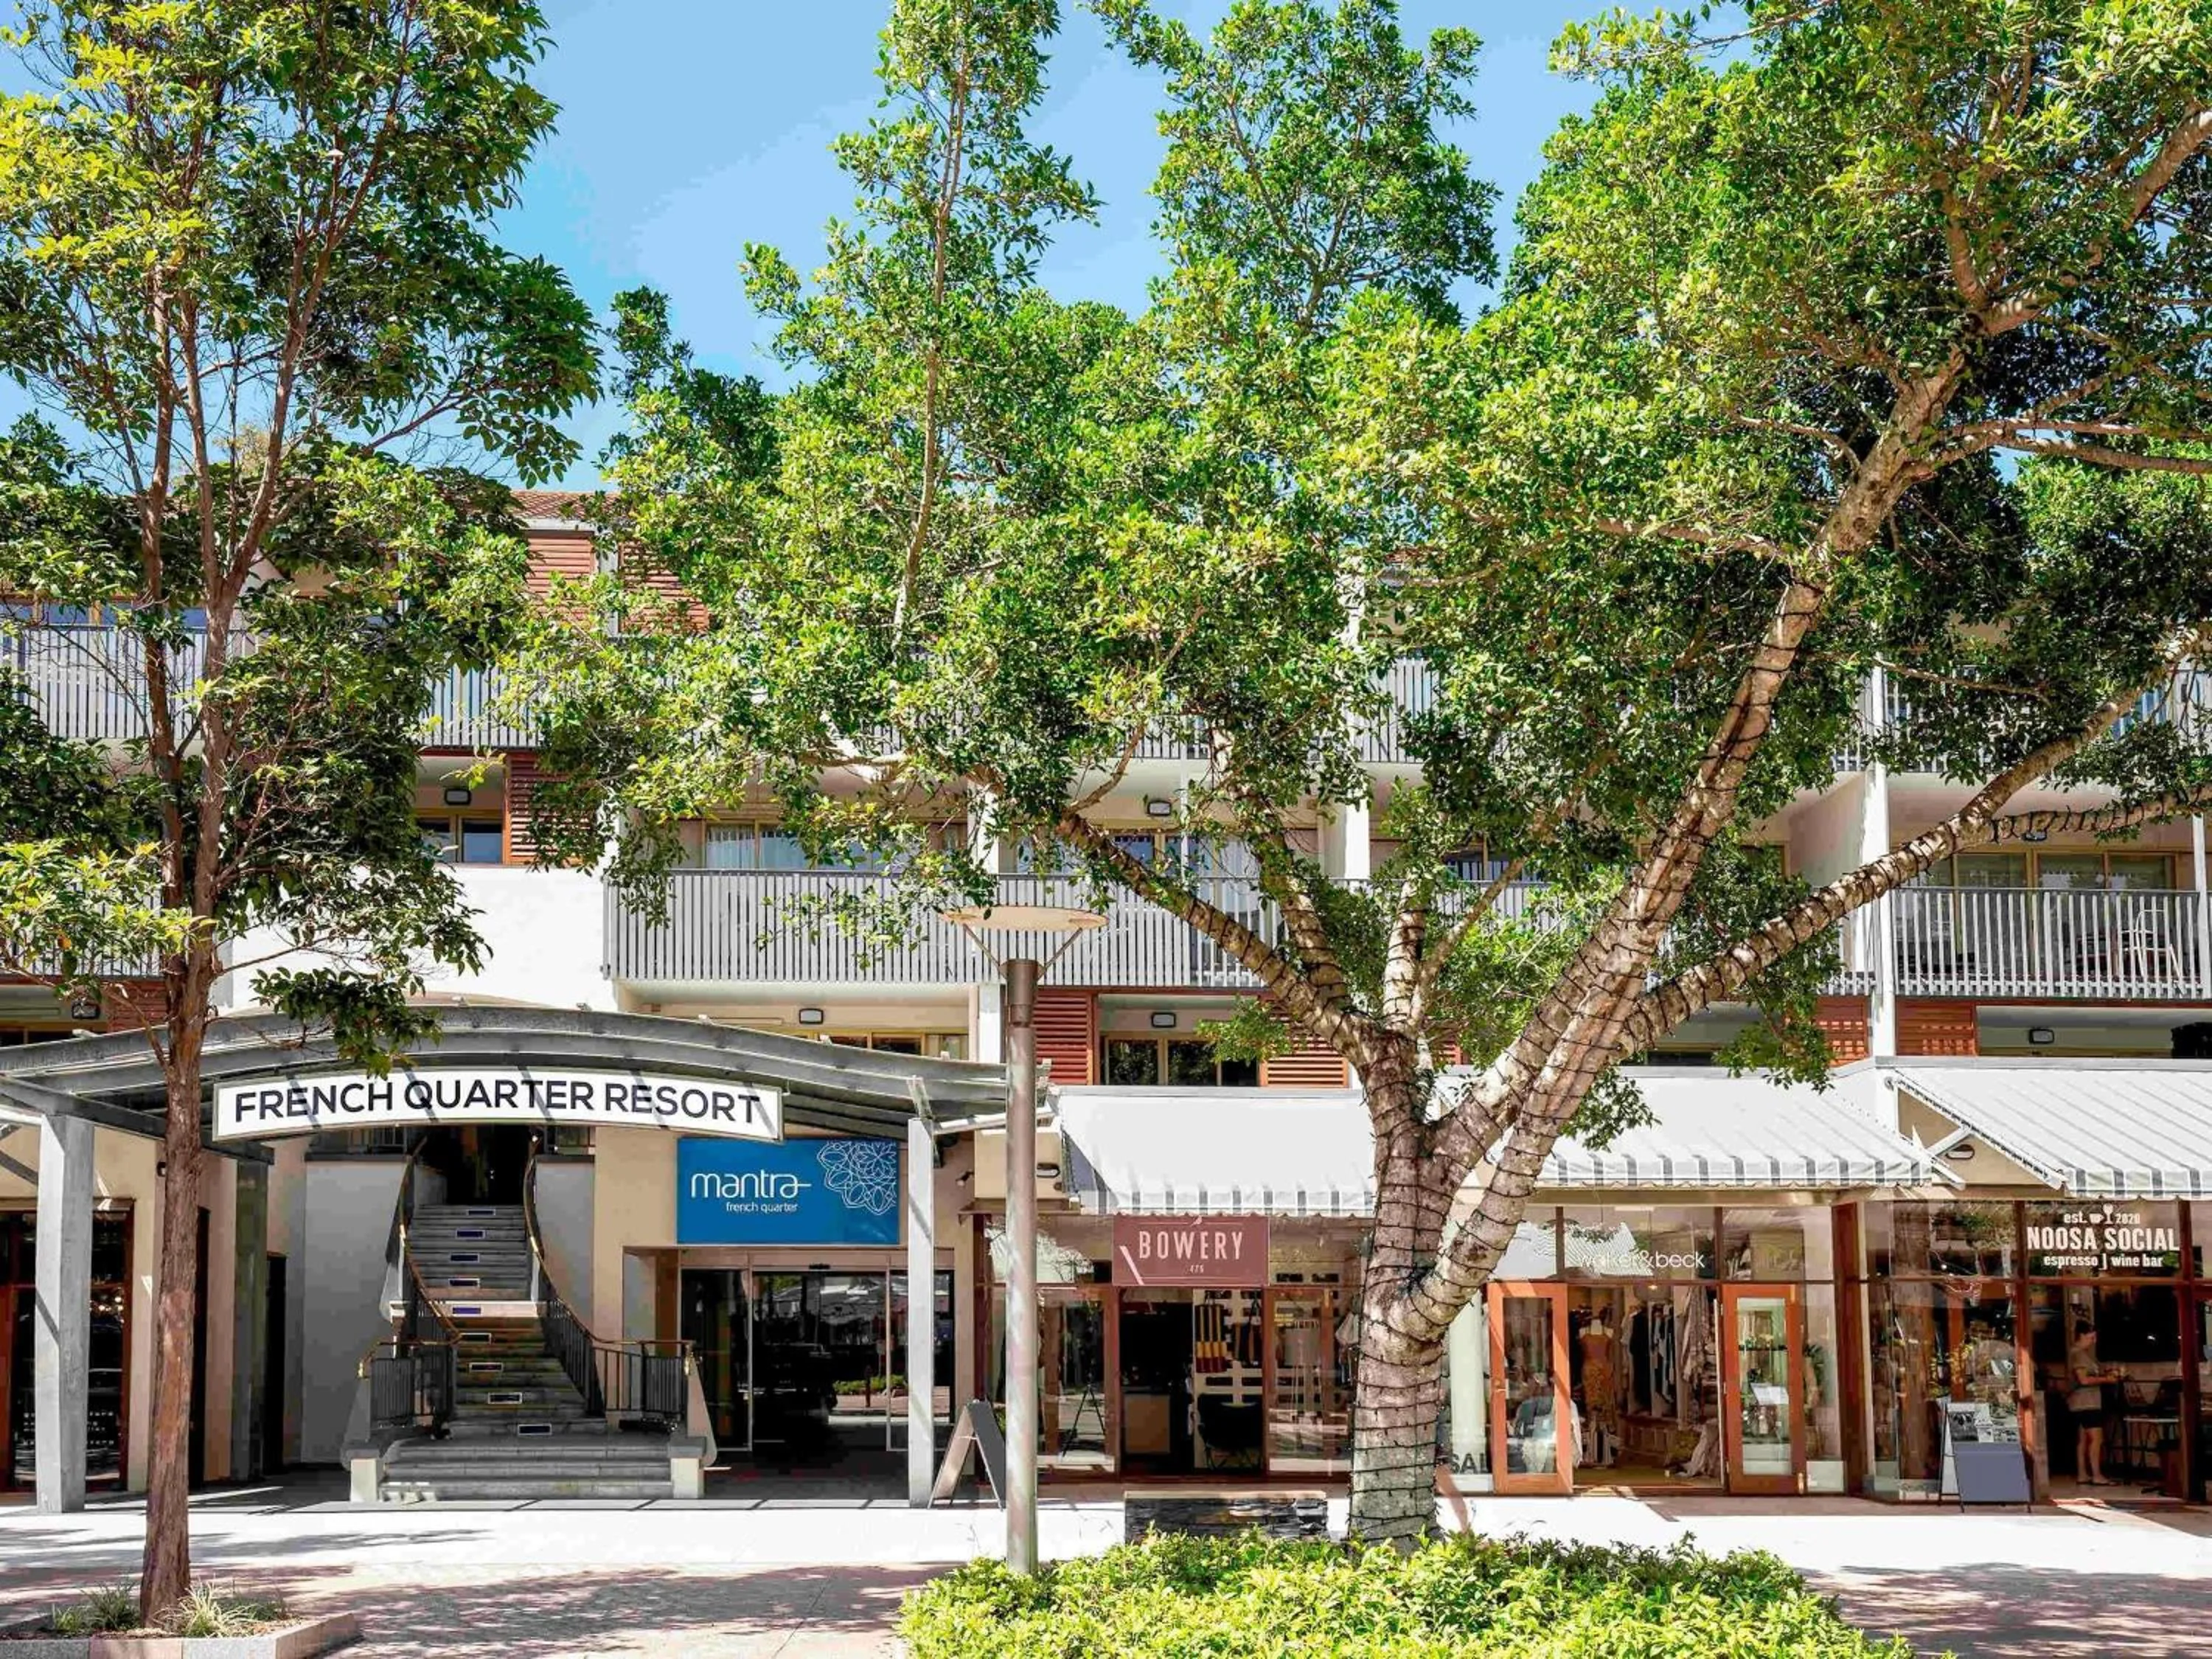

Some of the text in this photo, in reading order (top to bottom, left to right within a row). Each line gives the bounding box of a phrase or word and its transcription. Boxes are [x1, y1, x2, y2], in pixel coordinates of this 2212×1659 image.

[234, 1078, 760, 1124] FRENCH QUARTER RESORT
[690, 1169, 812, 1200] mantra
[726, 1201, 799, 1214] french quarter
[2115, 1213, 2140, 1225] 2020
[1138, 1230, 1244, 1260] BOWERY
[2028, 1226, 2180, 1251] NOOSA SOCIAL
[2043, 1253, 2164, 1269] espresso wine bar
